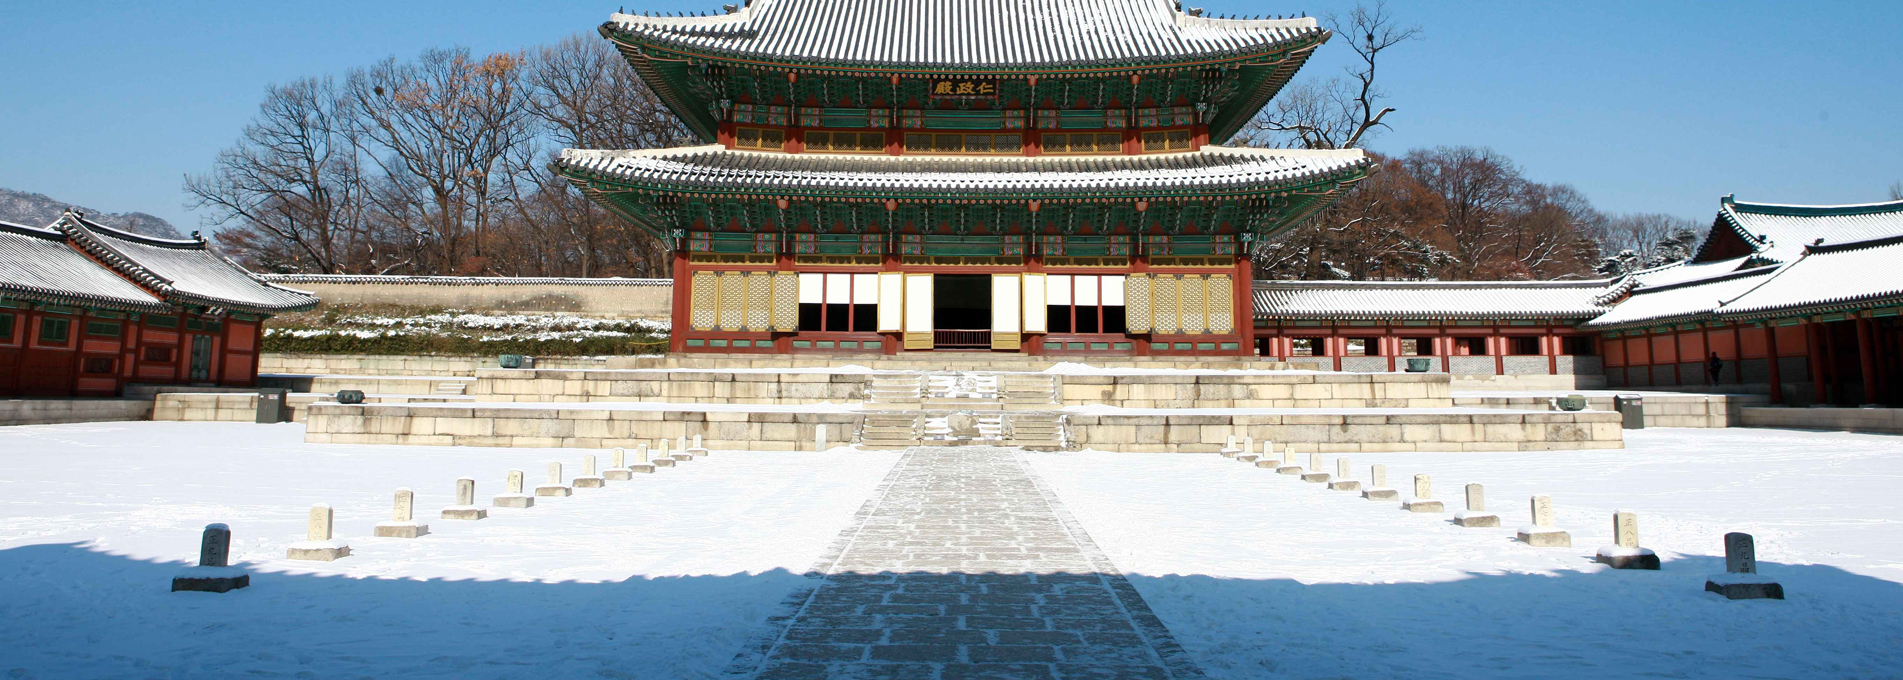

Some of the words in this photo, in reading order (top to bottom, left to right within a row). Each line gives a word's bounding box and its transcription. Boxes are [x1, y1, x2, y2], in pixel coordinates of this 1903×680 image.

[1623, 518, 1634, 547] 正八品
[205, 534, 219, 567] 正九品
[1737, 538, 1750, 573] 正九品
